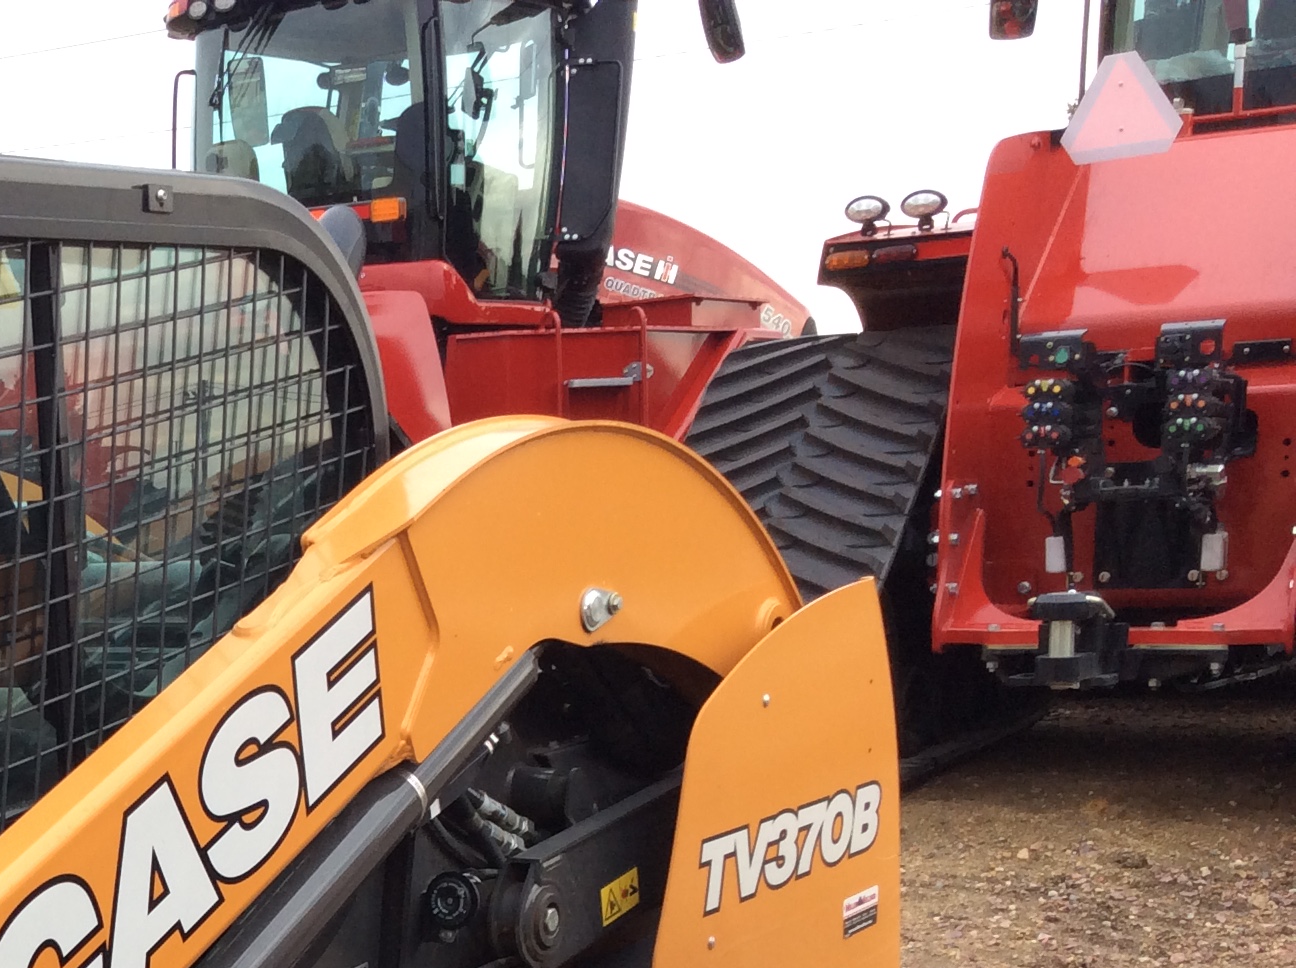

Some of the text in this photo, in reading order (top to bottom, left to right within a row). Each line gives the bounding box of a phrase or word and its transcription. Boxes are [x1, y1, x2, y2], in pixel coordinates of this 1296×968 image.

[605, 245, 654, 276] ASE
[604, 276, 664, 299] QUADTR
[699, 780, 882, 918] TV370B
